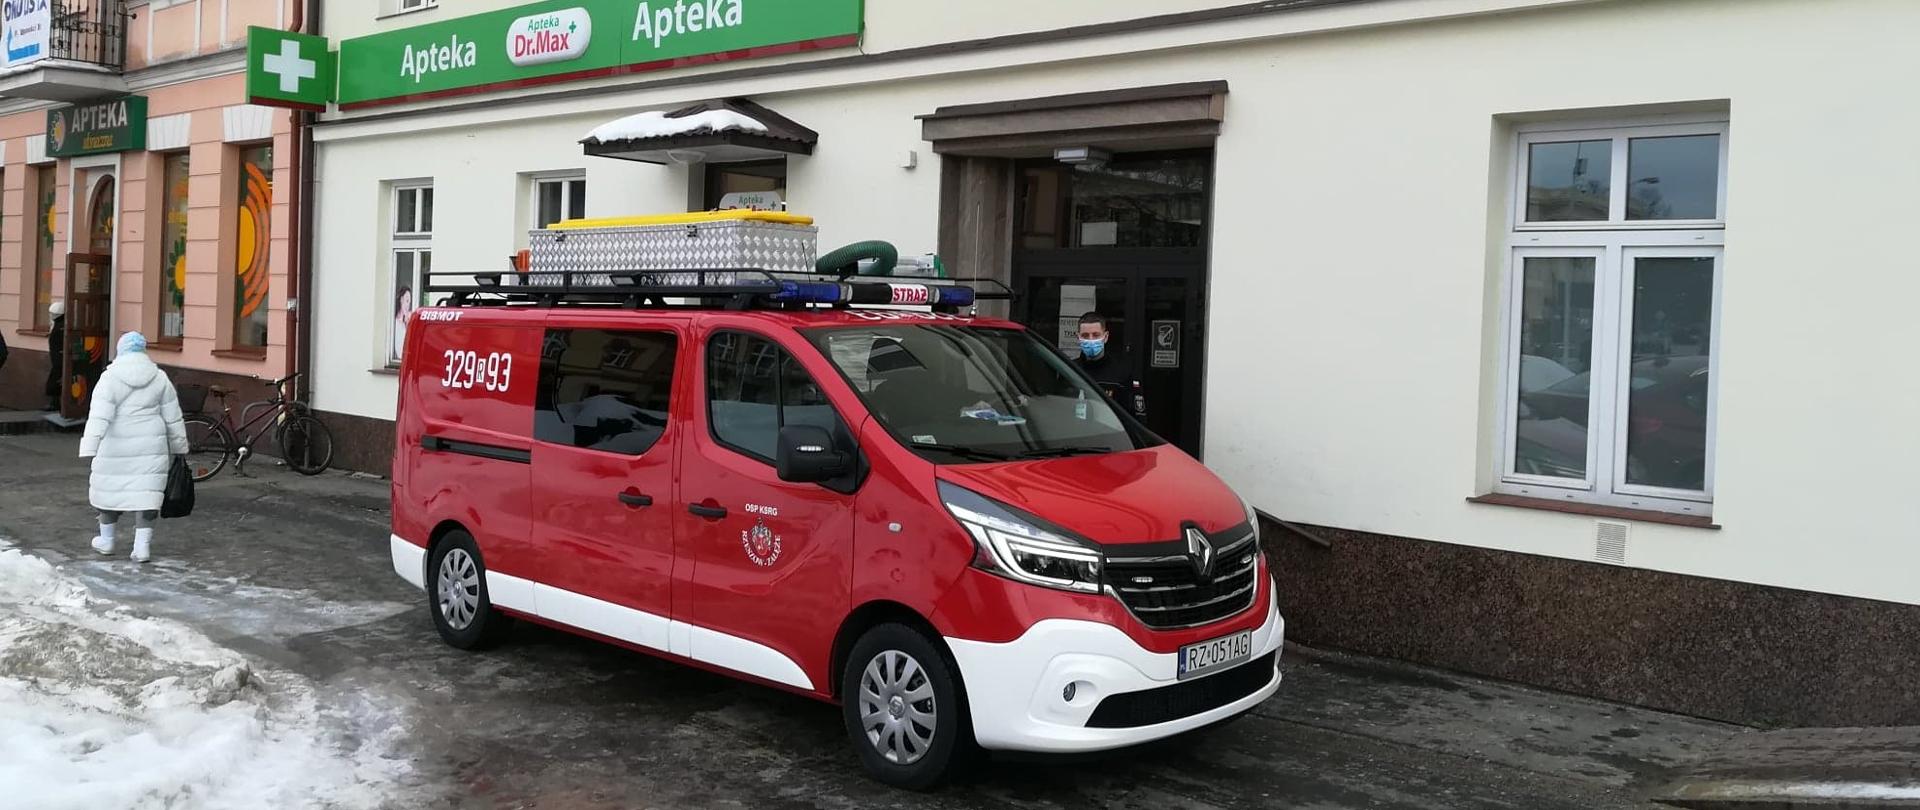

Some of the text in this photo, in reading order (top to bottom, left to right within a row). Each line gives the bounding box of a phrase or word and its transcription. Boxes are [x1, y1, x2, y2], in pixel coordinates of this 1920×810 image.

[528, 15, 560, 33] Apteka
[631, 0, 743, 48] Apteka
[514, 30, 570, 58] Dr.Max
[400, 34, 477, 83] Apteka
[71, 100, 128, 133] APTEKA
[420, 310, 464, 321] BIBMOT
[745, 503, 759, 513] OSP
